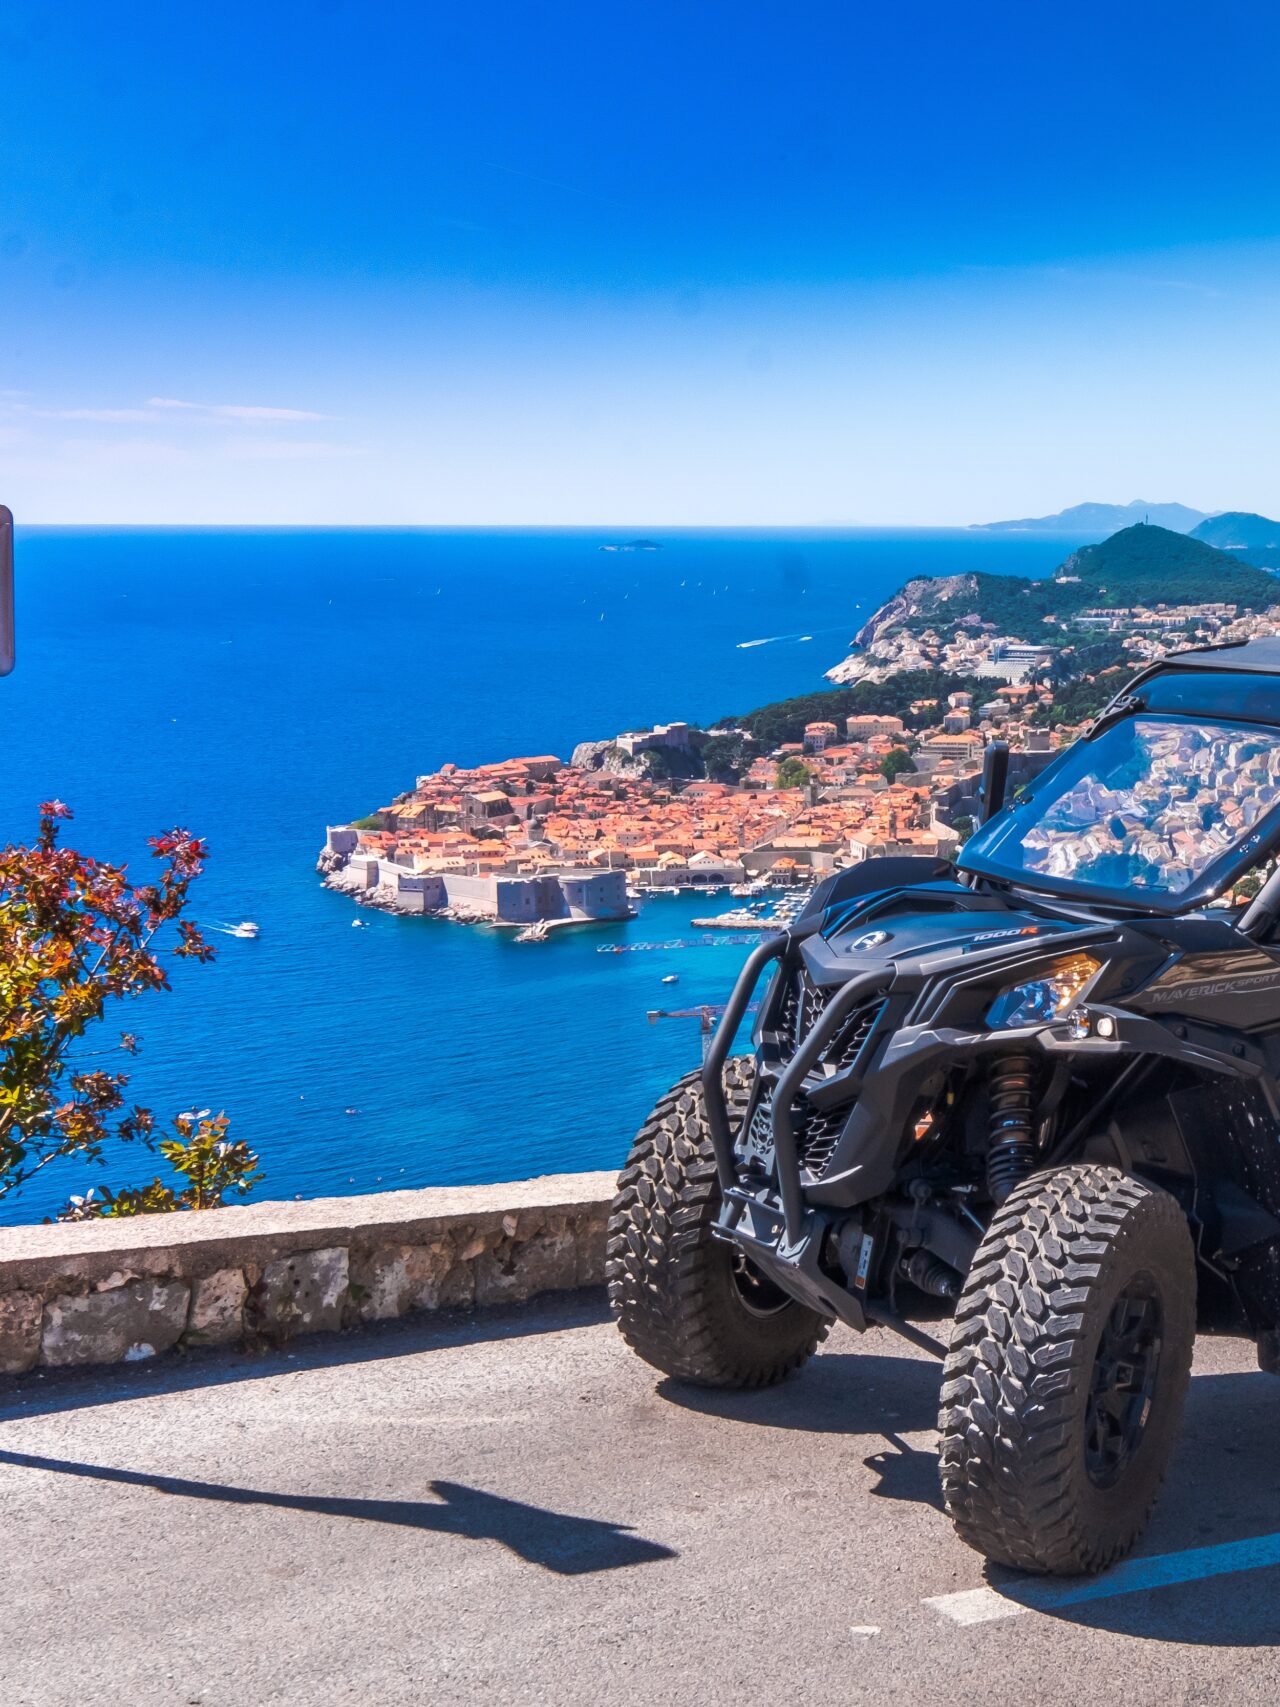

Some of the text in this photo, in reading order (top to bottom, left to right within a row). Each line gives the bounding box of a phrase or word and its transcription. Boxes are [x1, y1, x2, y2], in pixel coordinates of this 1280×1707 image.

[973, 926, 1039, 942] 1000R
[1152, 973, 1280, 1003] MAVERICK SPORT
